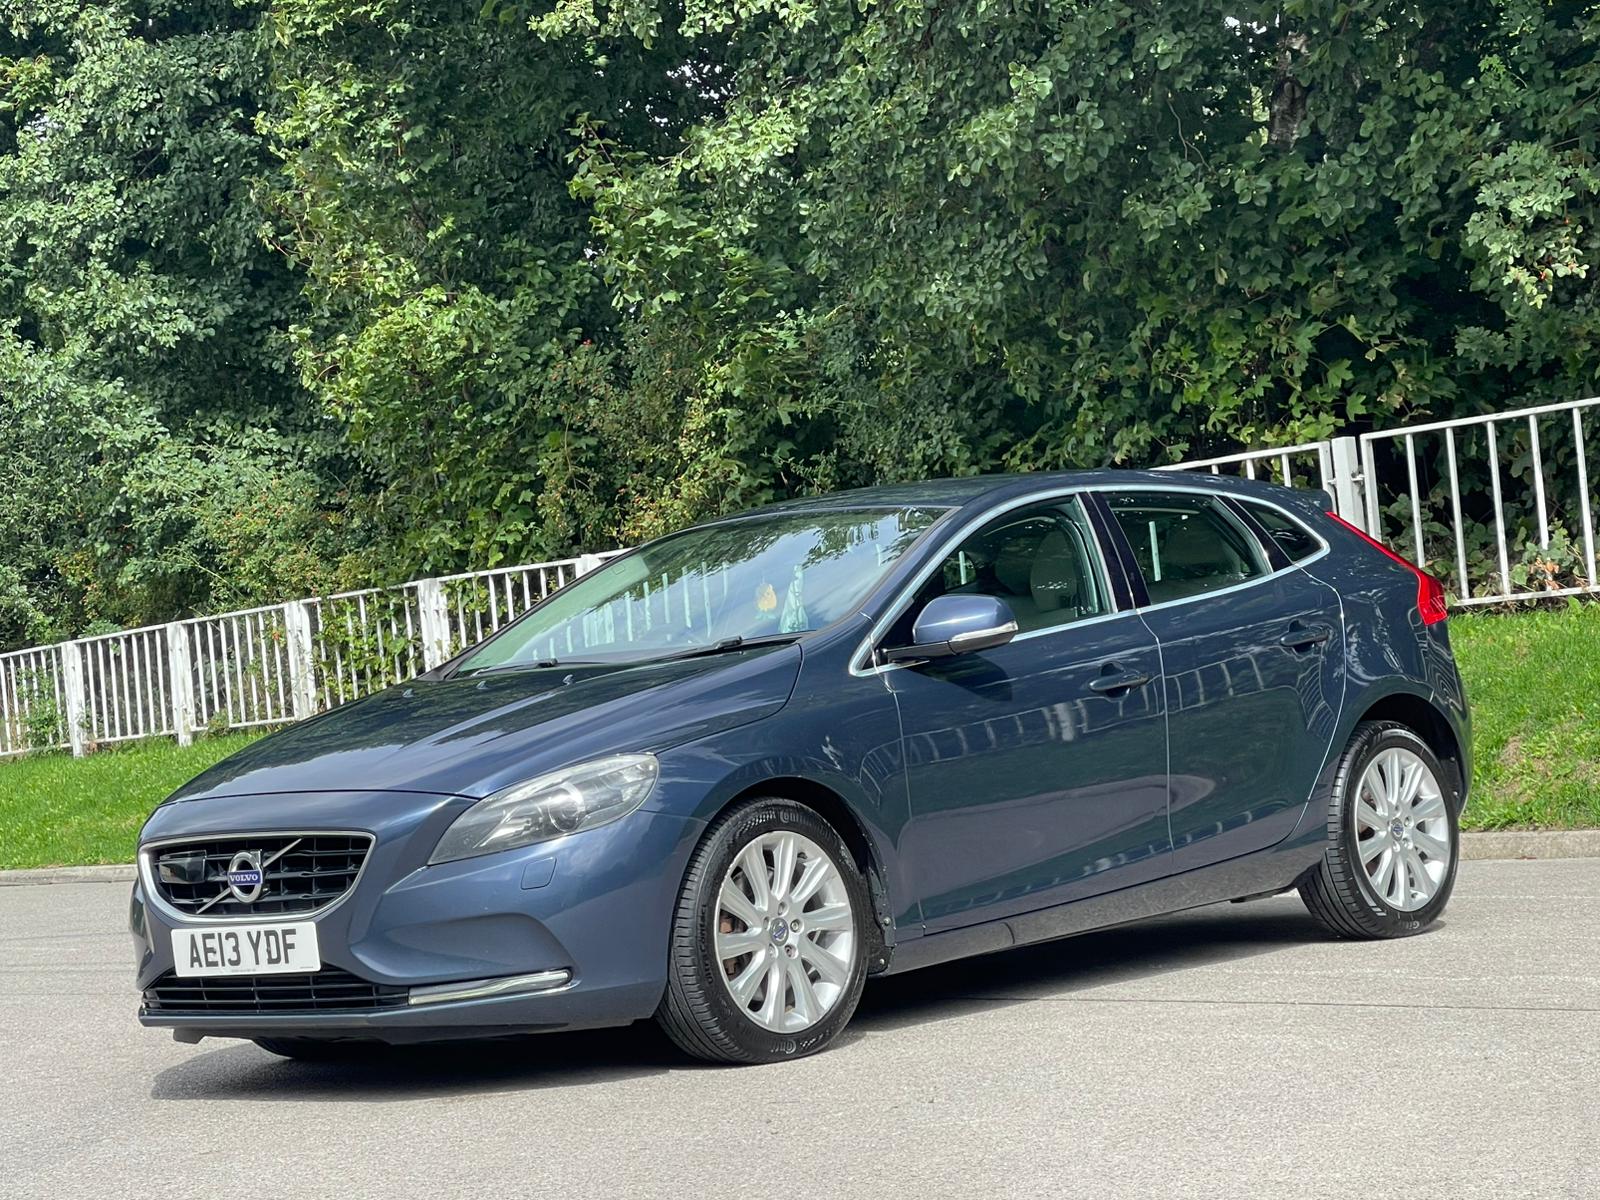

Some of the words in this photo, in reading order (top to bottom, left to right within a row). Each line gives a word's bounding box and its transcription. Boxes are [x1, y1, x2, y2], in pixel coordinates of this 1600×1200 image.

[229, 873, 259, 882] VOLVO
[190, 932, 241, 968] AE13
[247, 929, 296, 965] YDF
